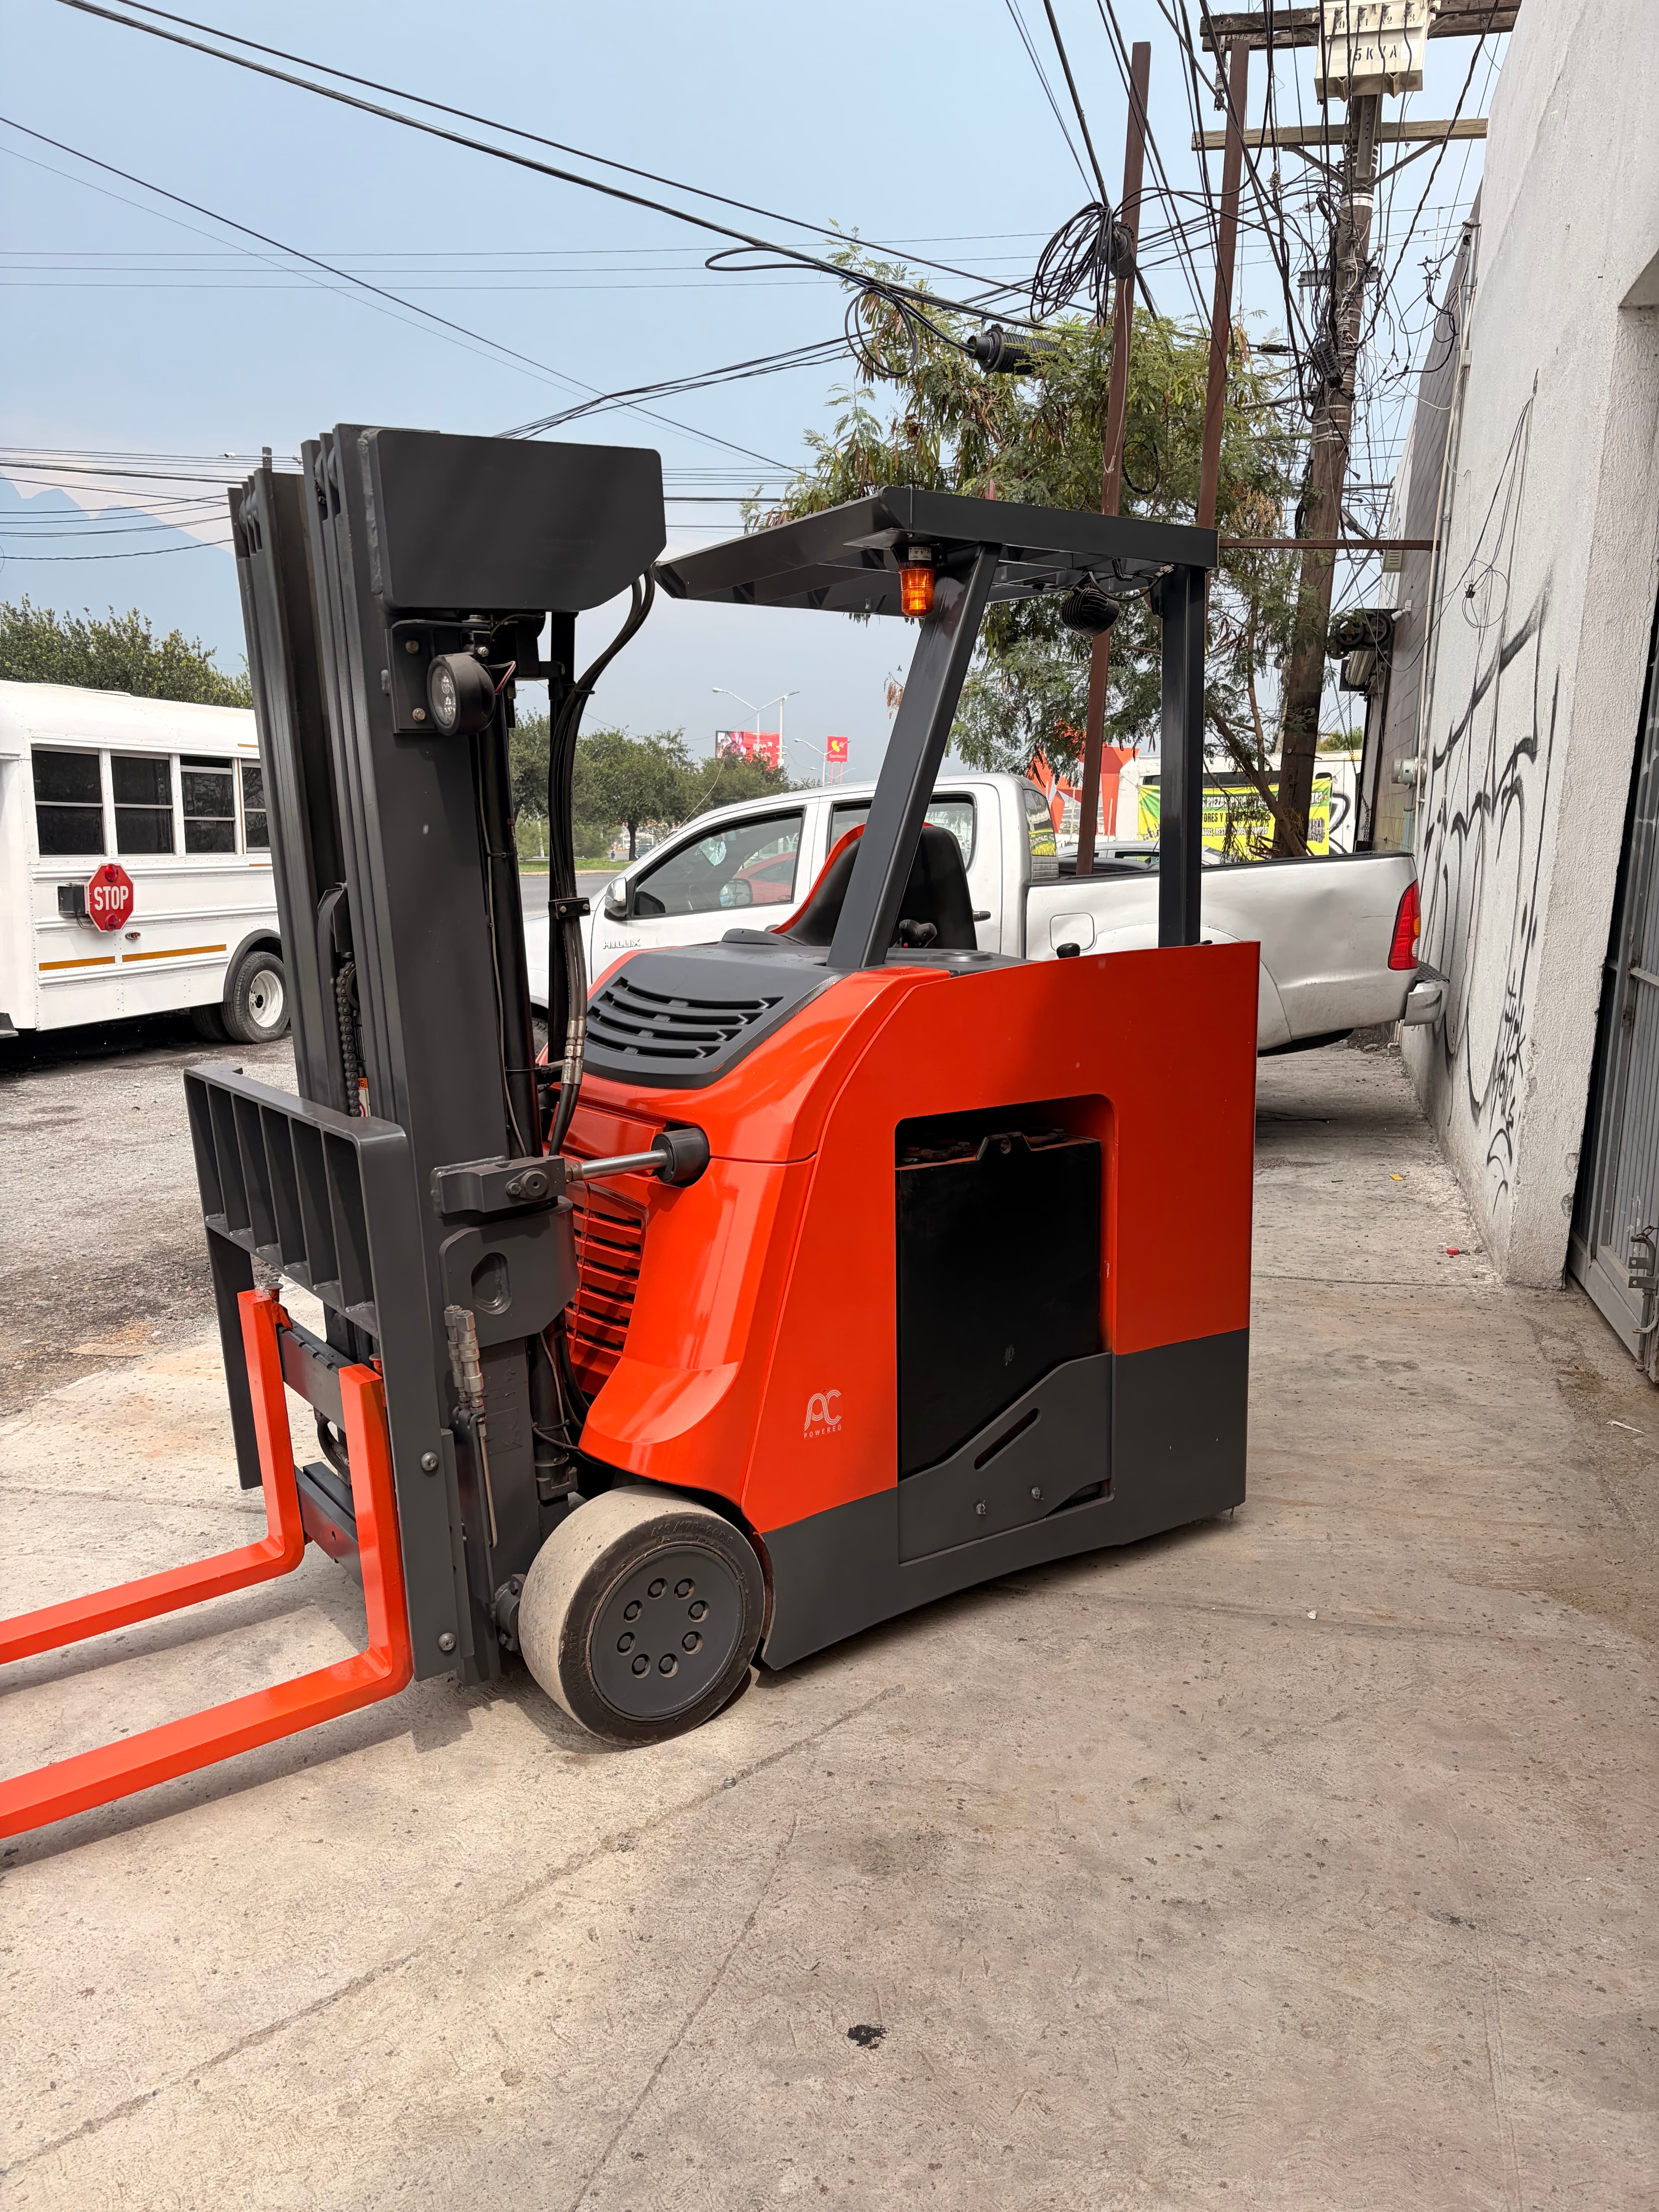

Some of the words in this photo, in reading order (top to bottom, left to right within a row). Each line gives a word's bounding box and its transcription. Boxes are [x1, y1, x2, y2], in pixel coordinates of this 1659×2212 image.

[1202, 813, 1218, 823] ORES
[94, 886, 129, 911] STOP
[603, 938, 641, 950] HILUX
[804, 1424, 842, 1439] POWERED
